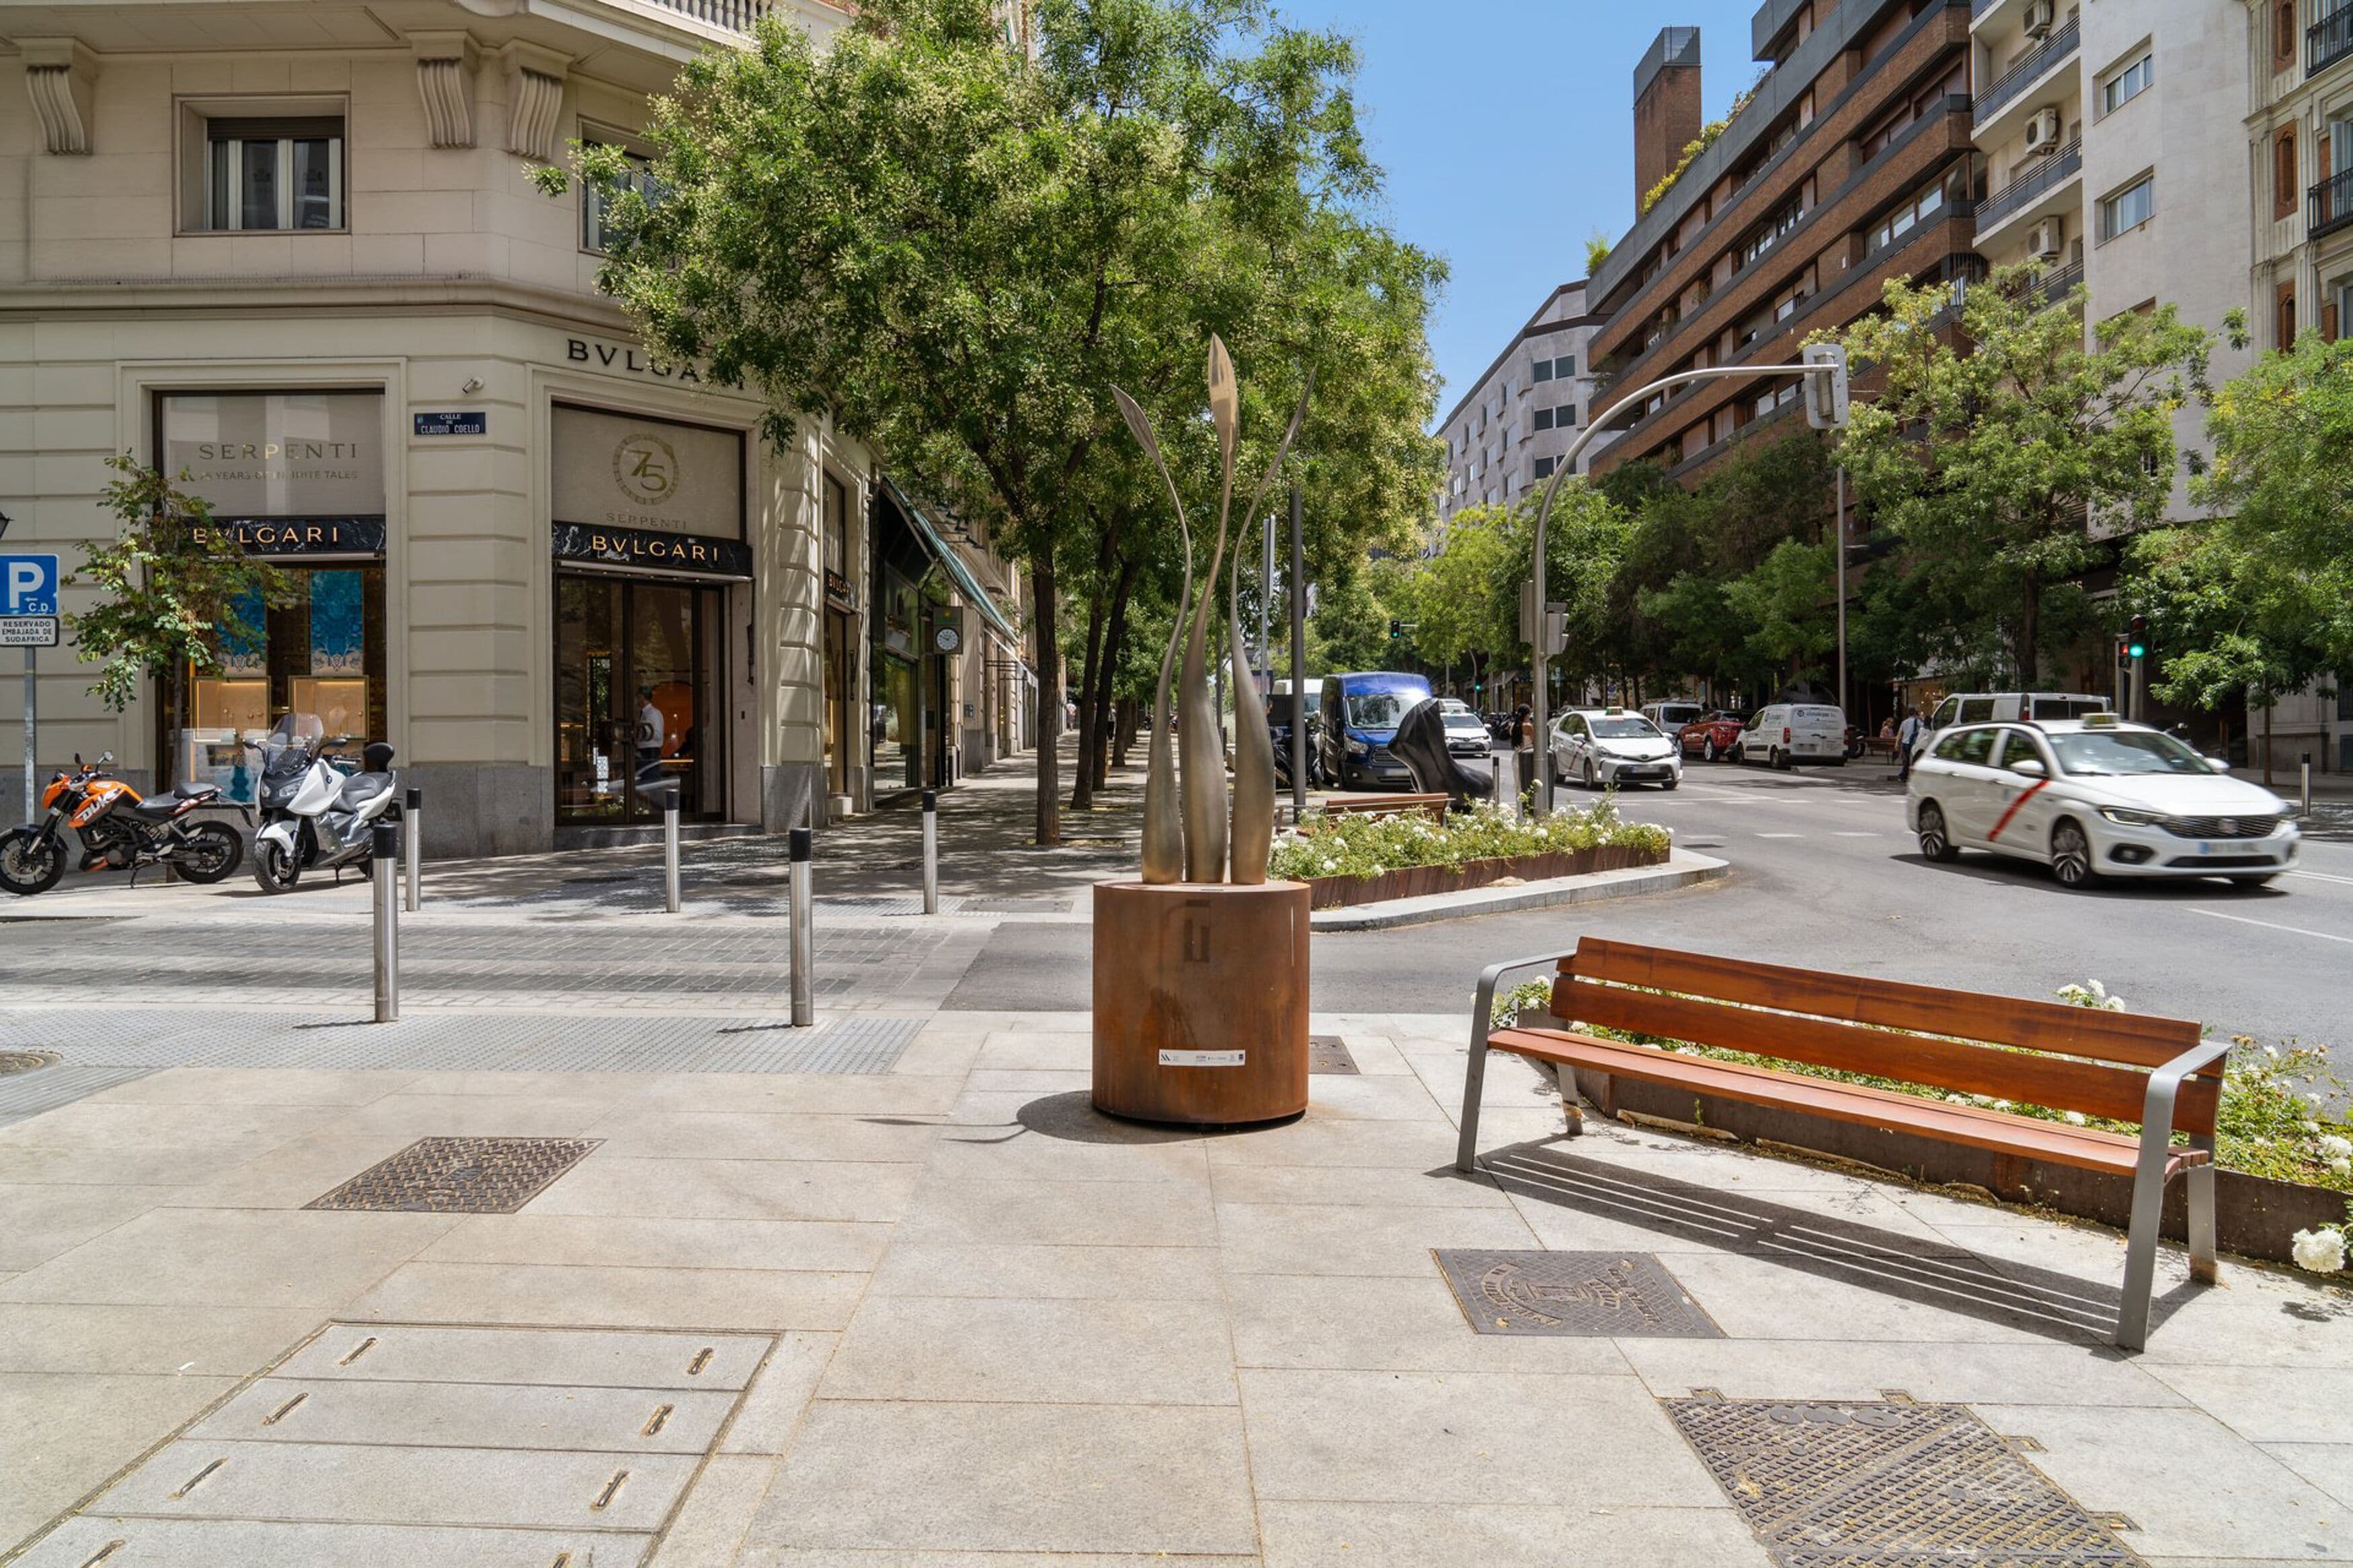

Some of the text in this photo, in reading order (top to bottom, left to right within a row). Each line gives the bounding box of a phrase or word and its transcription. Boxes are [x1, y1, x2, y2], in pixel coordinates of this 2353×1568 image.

[421, 424, 479, 434] CLAUDIO COELLO
[199, 444, 356, 460] SERPENTI
[628, 449, 667, 491] 75
[606, 513, 687, 530] SERPENTI
[592, 535, 718, 561] BVLGARI
[9, 562, 44, 608] P
[28, 603, 53, 612] C.D.
